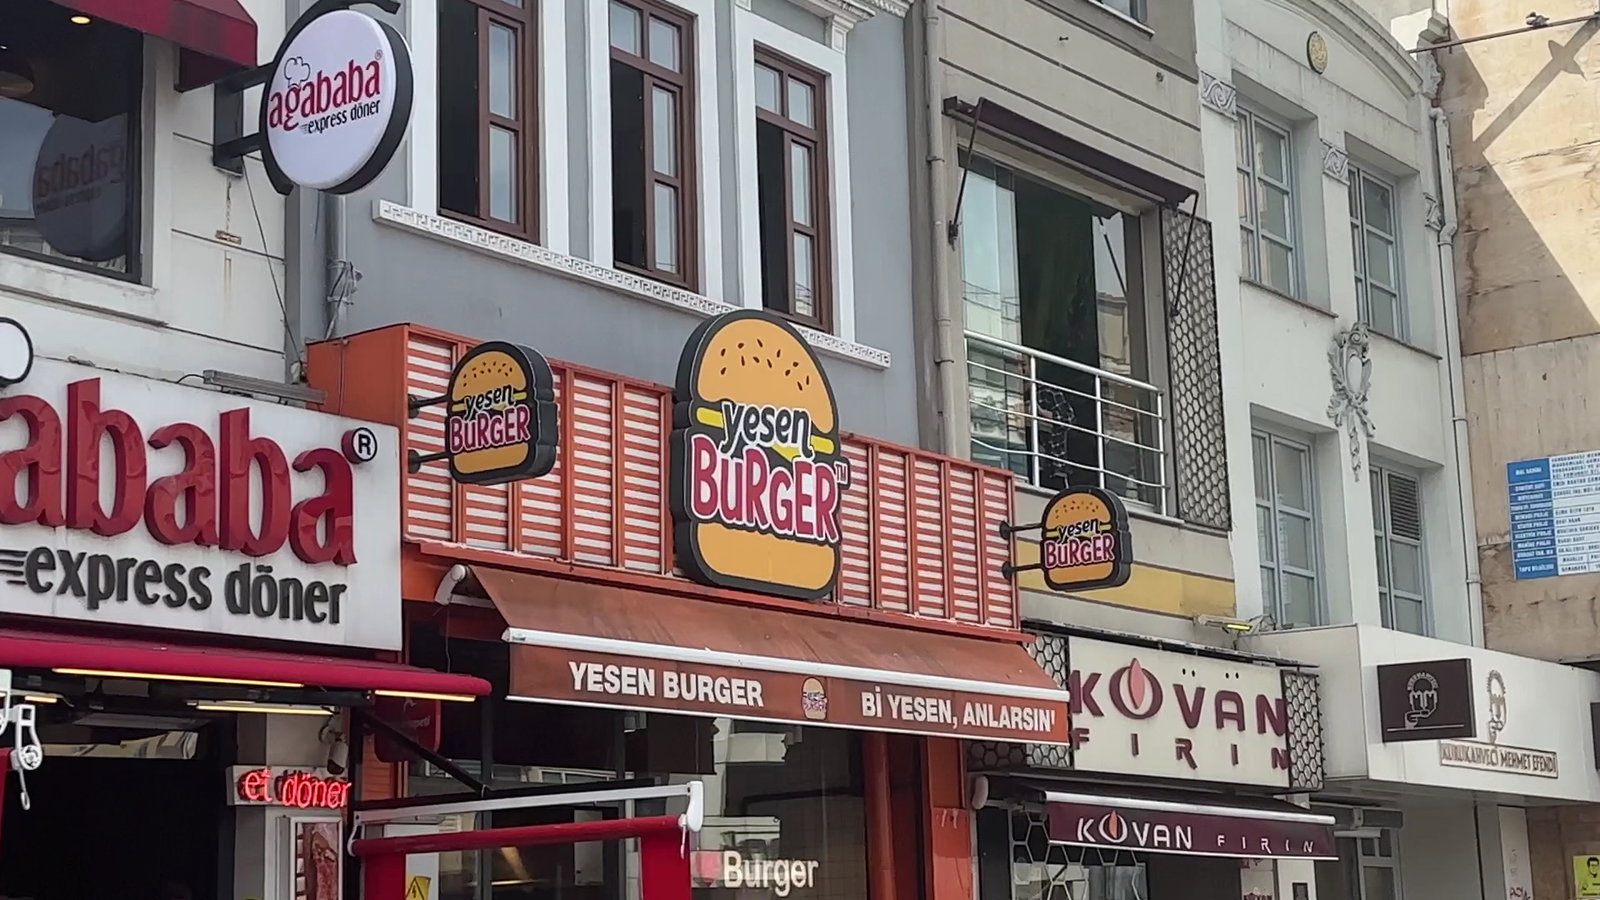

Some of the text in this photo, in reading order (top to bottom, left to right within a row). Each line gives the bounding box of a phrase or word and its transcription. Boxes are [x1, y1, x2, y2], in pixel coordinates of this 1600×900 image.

[269, 59, 381, 132] agababa
[307, 99, 381, 134] express döner
[464, 385, 514, 420] yesen
[721, 401, 815, 460] yesen
[0, 377, 358, 565] ababa
[1057, 518, 1101, 544] yesen
[24, 546, 348, 625] express döner
[568, 661, 764, 707] YESEN BURGER
[1069, 658, 1288, 737] KOVAN
[861, 686, 883, 718] Bİ
[887, 694, 958, 730] YESEN,
[1071, 727, 1290, 770] FIRIN
[245, 767, 352, 808] et döner
[1077, 810, 1314, 854] KOVAN FIRIN
[723, 850, 820, 897] Burger
